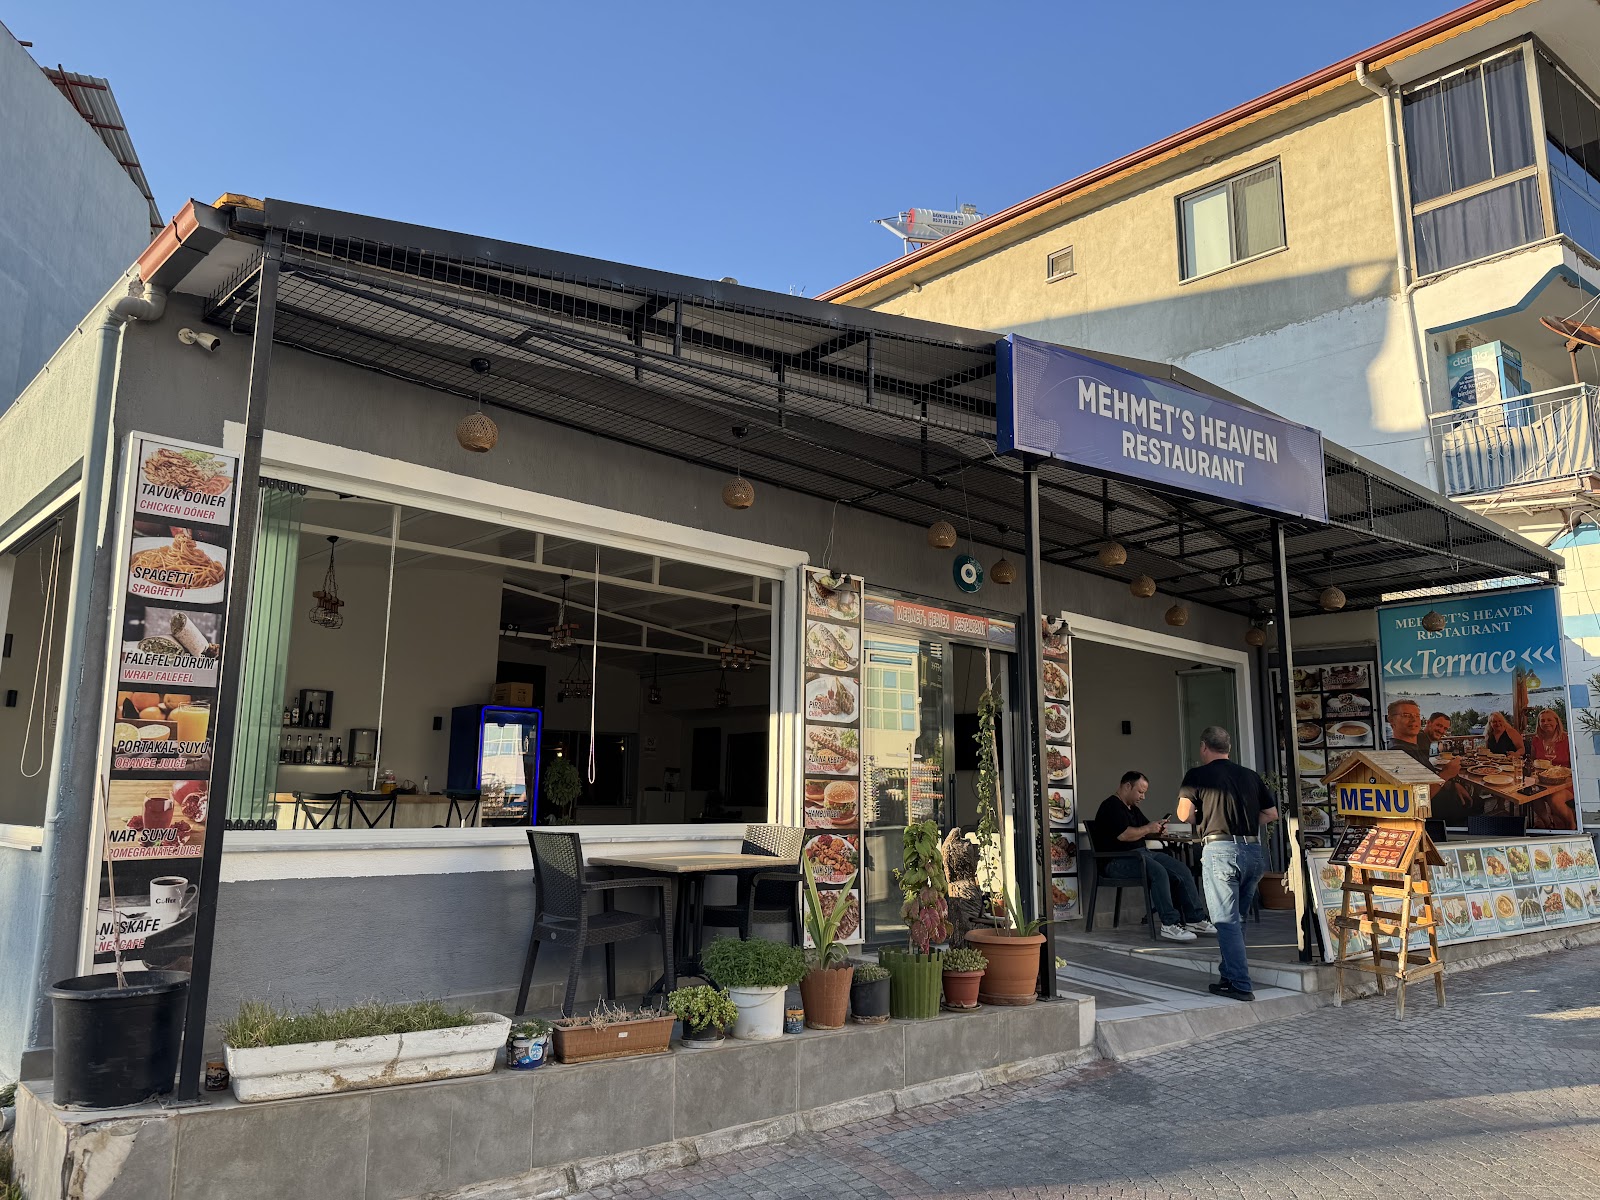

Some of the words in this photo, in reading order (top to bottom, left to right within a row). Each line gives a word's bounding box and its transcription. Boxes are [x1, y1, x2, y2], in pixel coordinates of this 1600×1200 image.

[1077, 378, 1195, 441] MEHMET'S
[1200, 414, 1279, 464] HEAVEN
[1122, 430, 1245, 486] RESTAURANT
[141, 483, 184, 500] TAVUK
[183, 489, 226, 508] DÖNER
[139, 499, 182, 514] CHICKEN
[1395, 610, 1470, 629] MEHET'S
[1473, 604, 1533, 621] HEAVEN
[1417, 621, 1512, 641] RESTAURANT
[124, 652, 172, 667] FALEFEL
[172, 654, 215, 670] DÜRÜM
[1416, 648, 1516, 679] Terrace
[124, 670, 154, 681] WRAP
[154, 671, 194, 683] FALEFEL
[115, 739, 176, 755] PORTAKAL
[176, 740, 210, 755] SUYU
[114, 756, 156, 769] ORANGE
[156, 757, 187, 769] JUICE
[1340, 787, 1410, 813] MENU
[109, 829, 137, 843] NAR
[140, 828, 177, 842] SUYU
[109, 845, 175, 859] POMEGRANATE
[174, 844, 201, 857] JUICE
